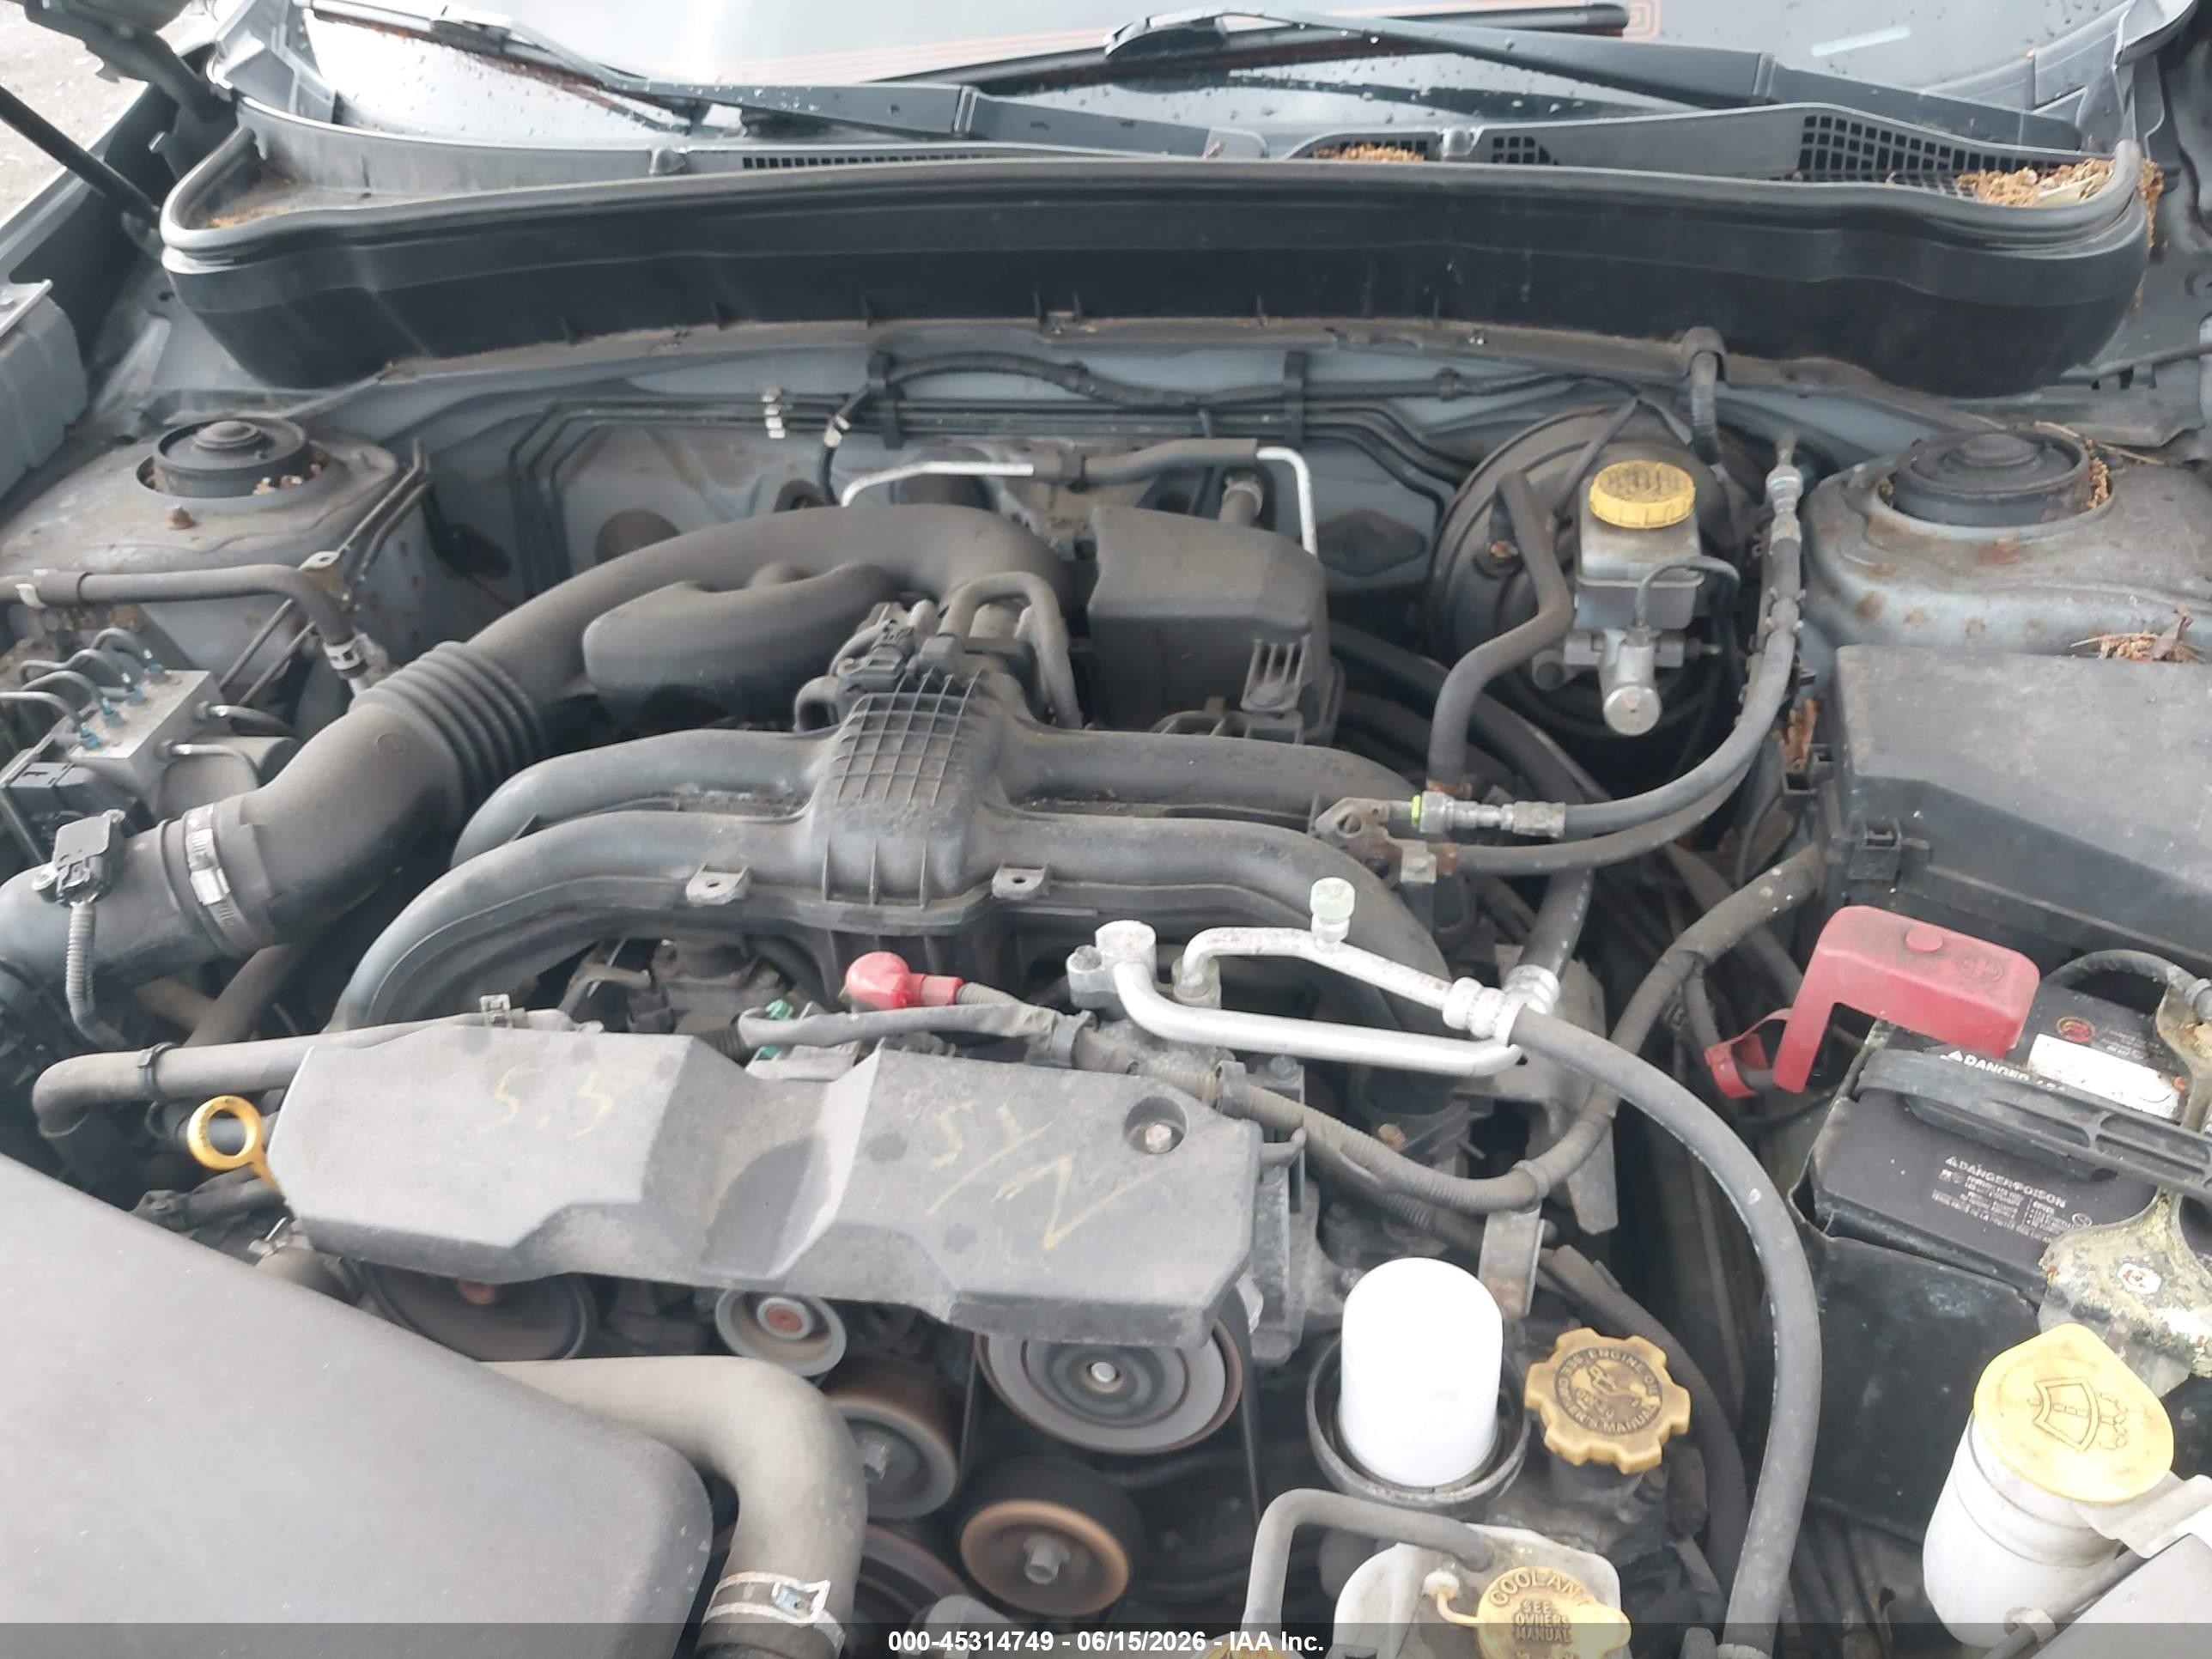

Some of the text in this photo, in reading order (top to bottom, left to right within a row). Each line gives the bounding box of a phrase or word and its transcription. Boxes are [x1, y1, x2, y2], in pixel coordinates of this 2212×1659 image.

[1588, 1347, 1645, 1374] ENGINE
[1521, 1600, 1553, 1613] SEE
[1514, 1626, 1572, 1643] MANUAL
